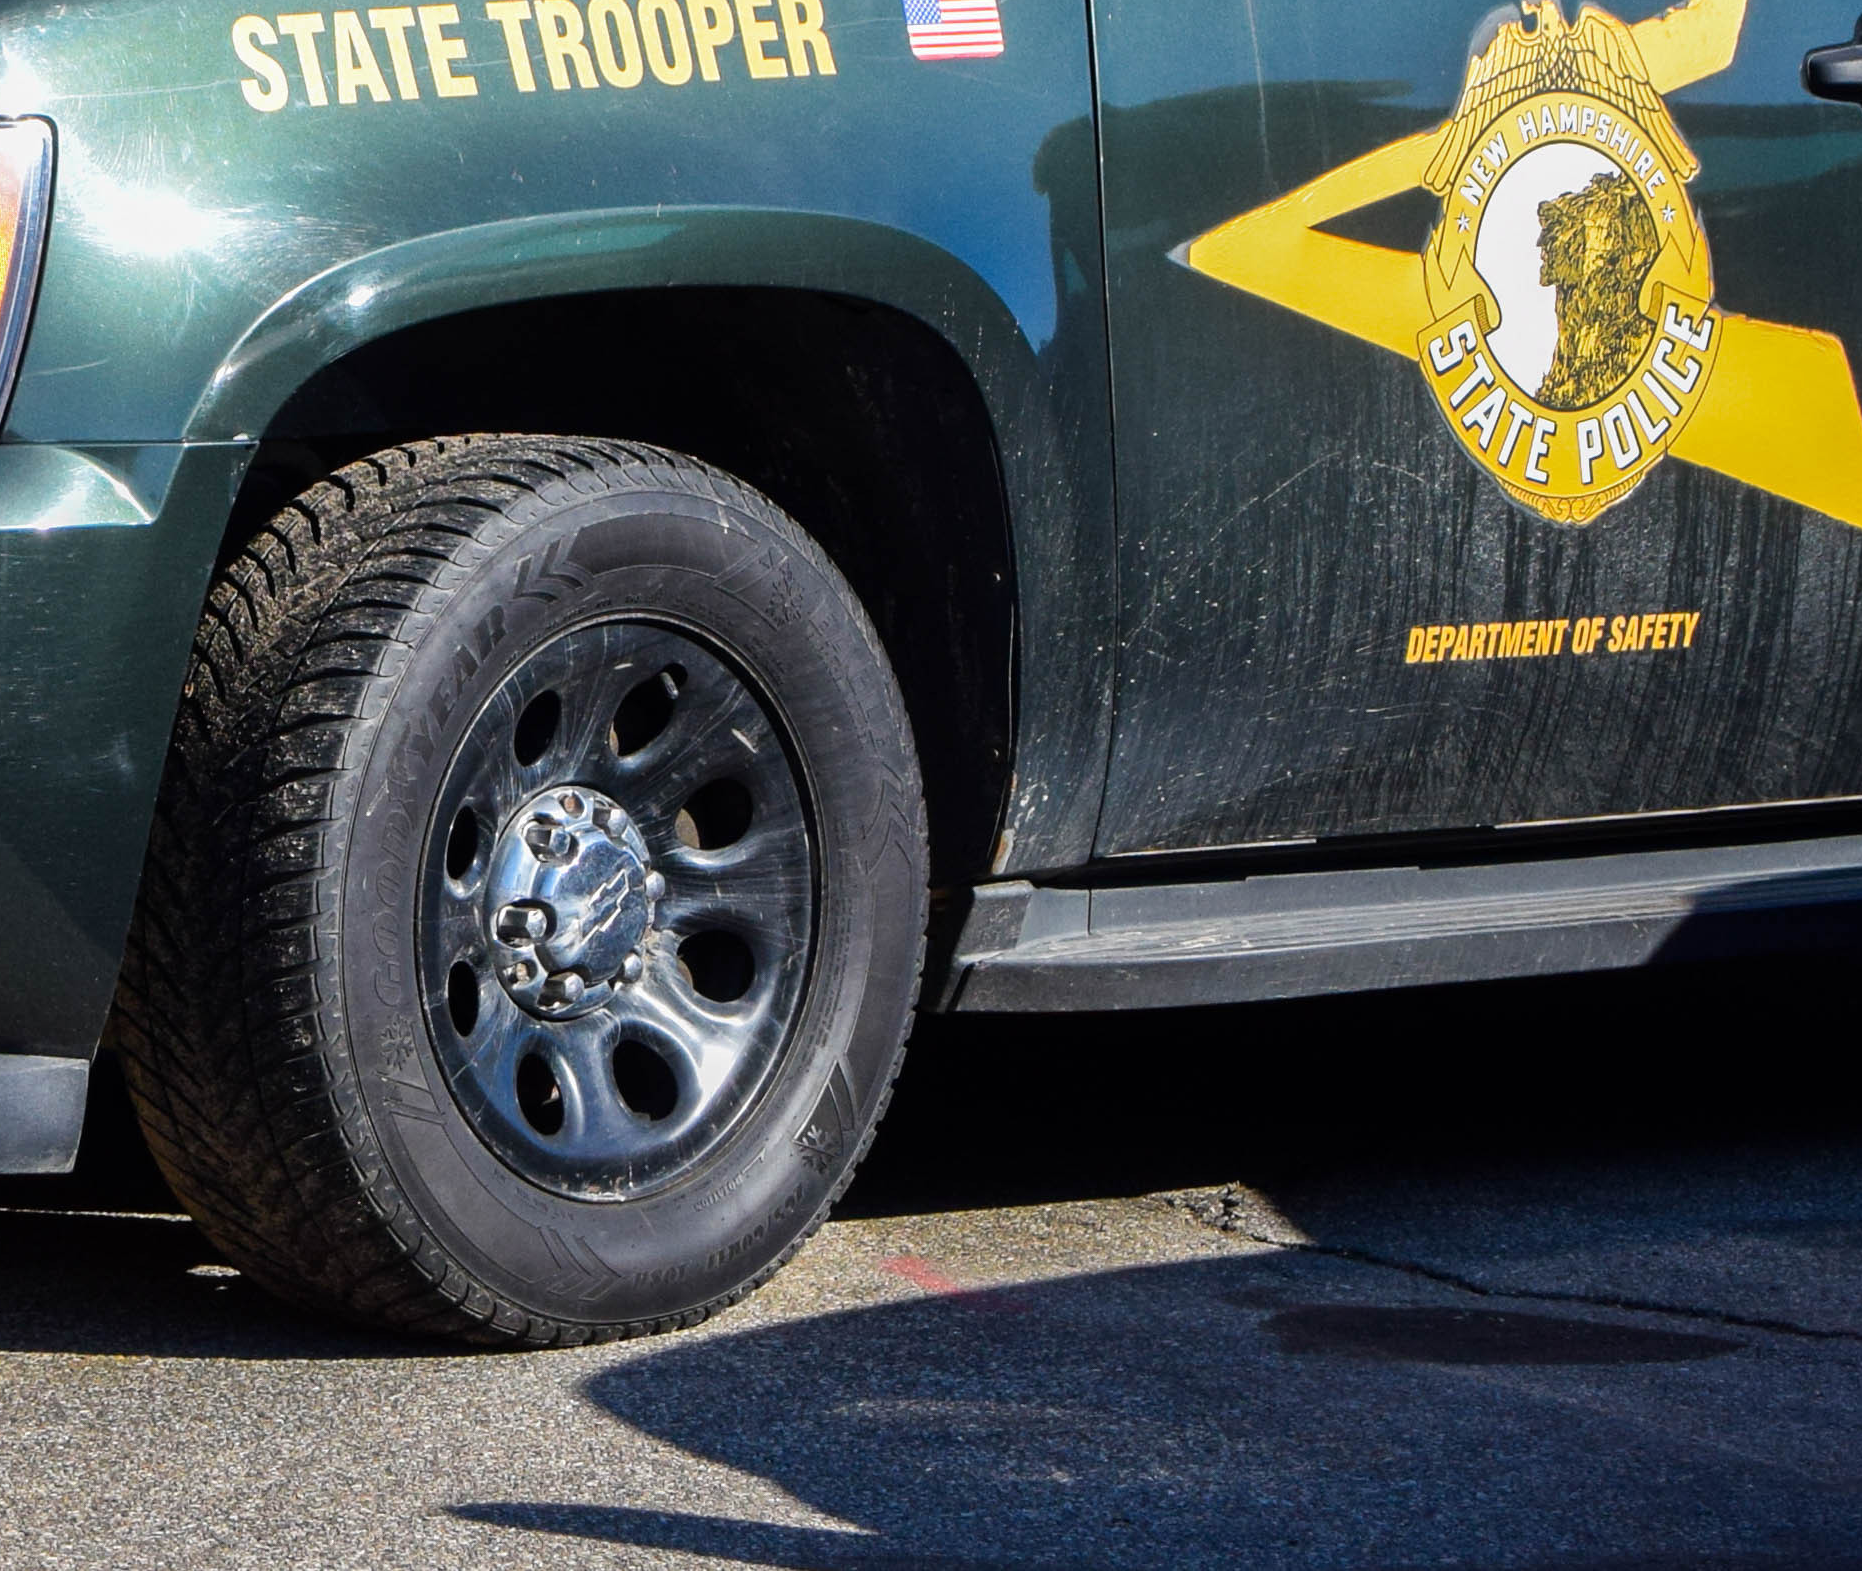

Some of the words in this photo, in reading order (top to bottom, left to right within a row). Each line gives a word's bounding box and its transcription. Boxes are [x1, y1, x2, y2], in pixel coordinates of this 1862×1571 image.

[231, 4, 479, 113] STATE
[1459, 132, 1511, 206] NEW
[1517, 104, 1669, 198] HAMPSHIRE
[1430, 320, 1555, 484] STATE
[1576, 301, 1715, 484] POLICE
[1406, 619, 1569, 664] DEPARTMENT
[1571, 617, 1606, 654] OF
[1607, 612, 1700, 651] SAFETY
